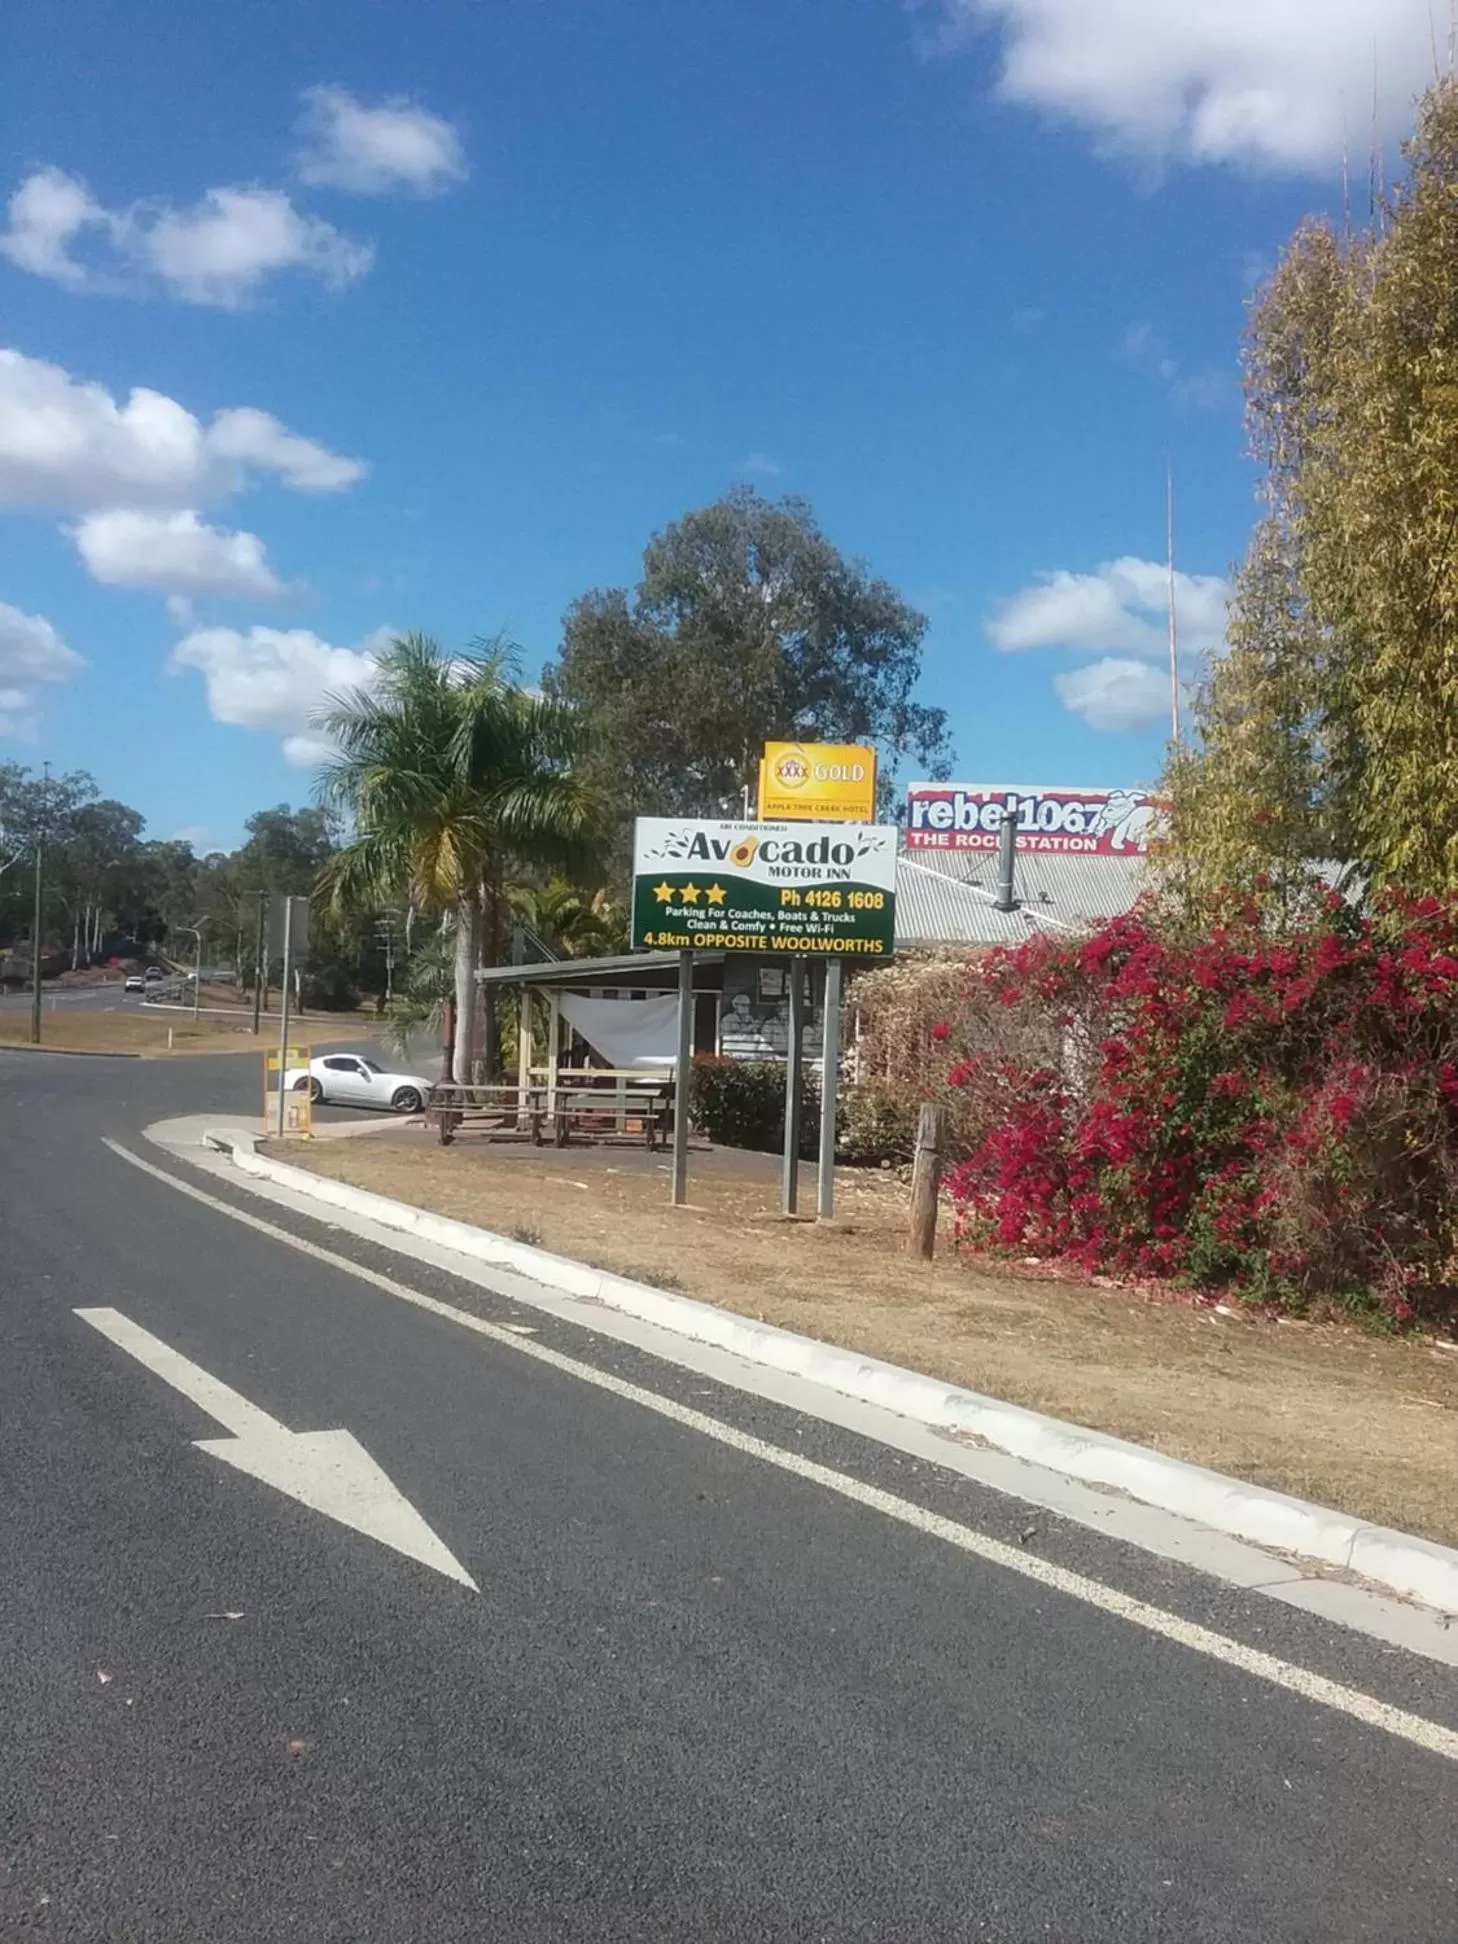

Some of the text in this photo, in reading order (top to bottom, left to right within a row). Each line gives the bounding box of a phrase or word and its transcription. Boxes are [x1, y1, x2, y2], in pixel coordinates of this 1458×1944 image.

[814, 764, 865, 782] GOLD
[843, 806, 868, 815] HOTEL
[687, 832, 855, 867] Avocado
[911, 833, 949, 846] THE
[1015, 836, 1097, 851] STATION
[768, 866, 851, 879] MOTOR INN
[781, 889, 884, 909] Ph 4126 1608
[665, 906, 855, 922] Parking For Coaches, Boats & Trucks
[686, 919, 835, 934] Clean & Comfy Free Wi-Fi
[643, 932, 884, 953] 4.8km OPPOSITE WOOLWORTHS
